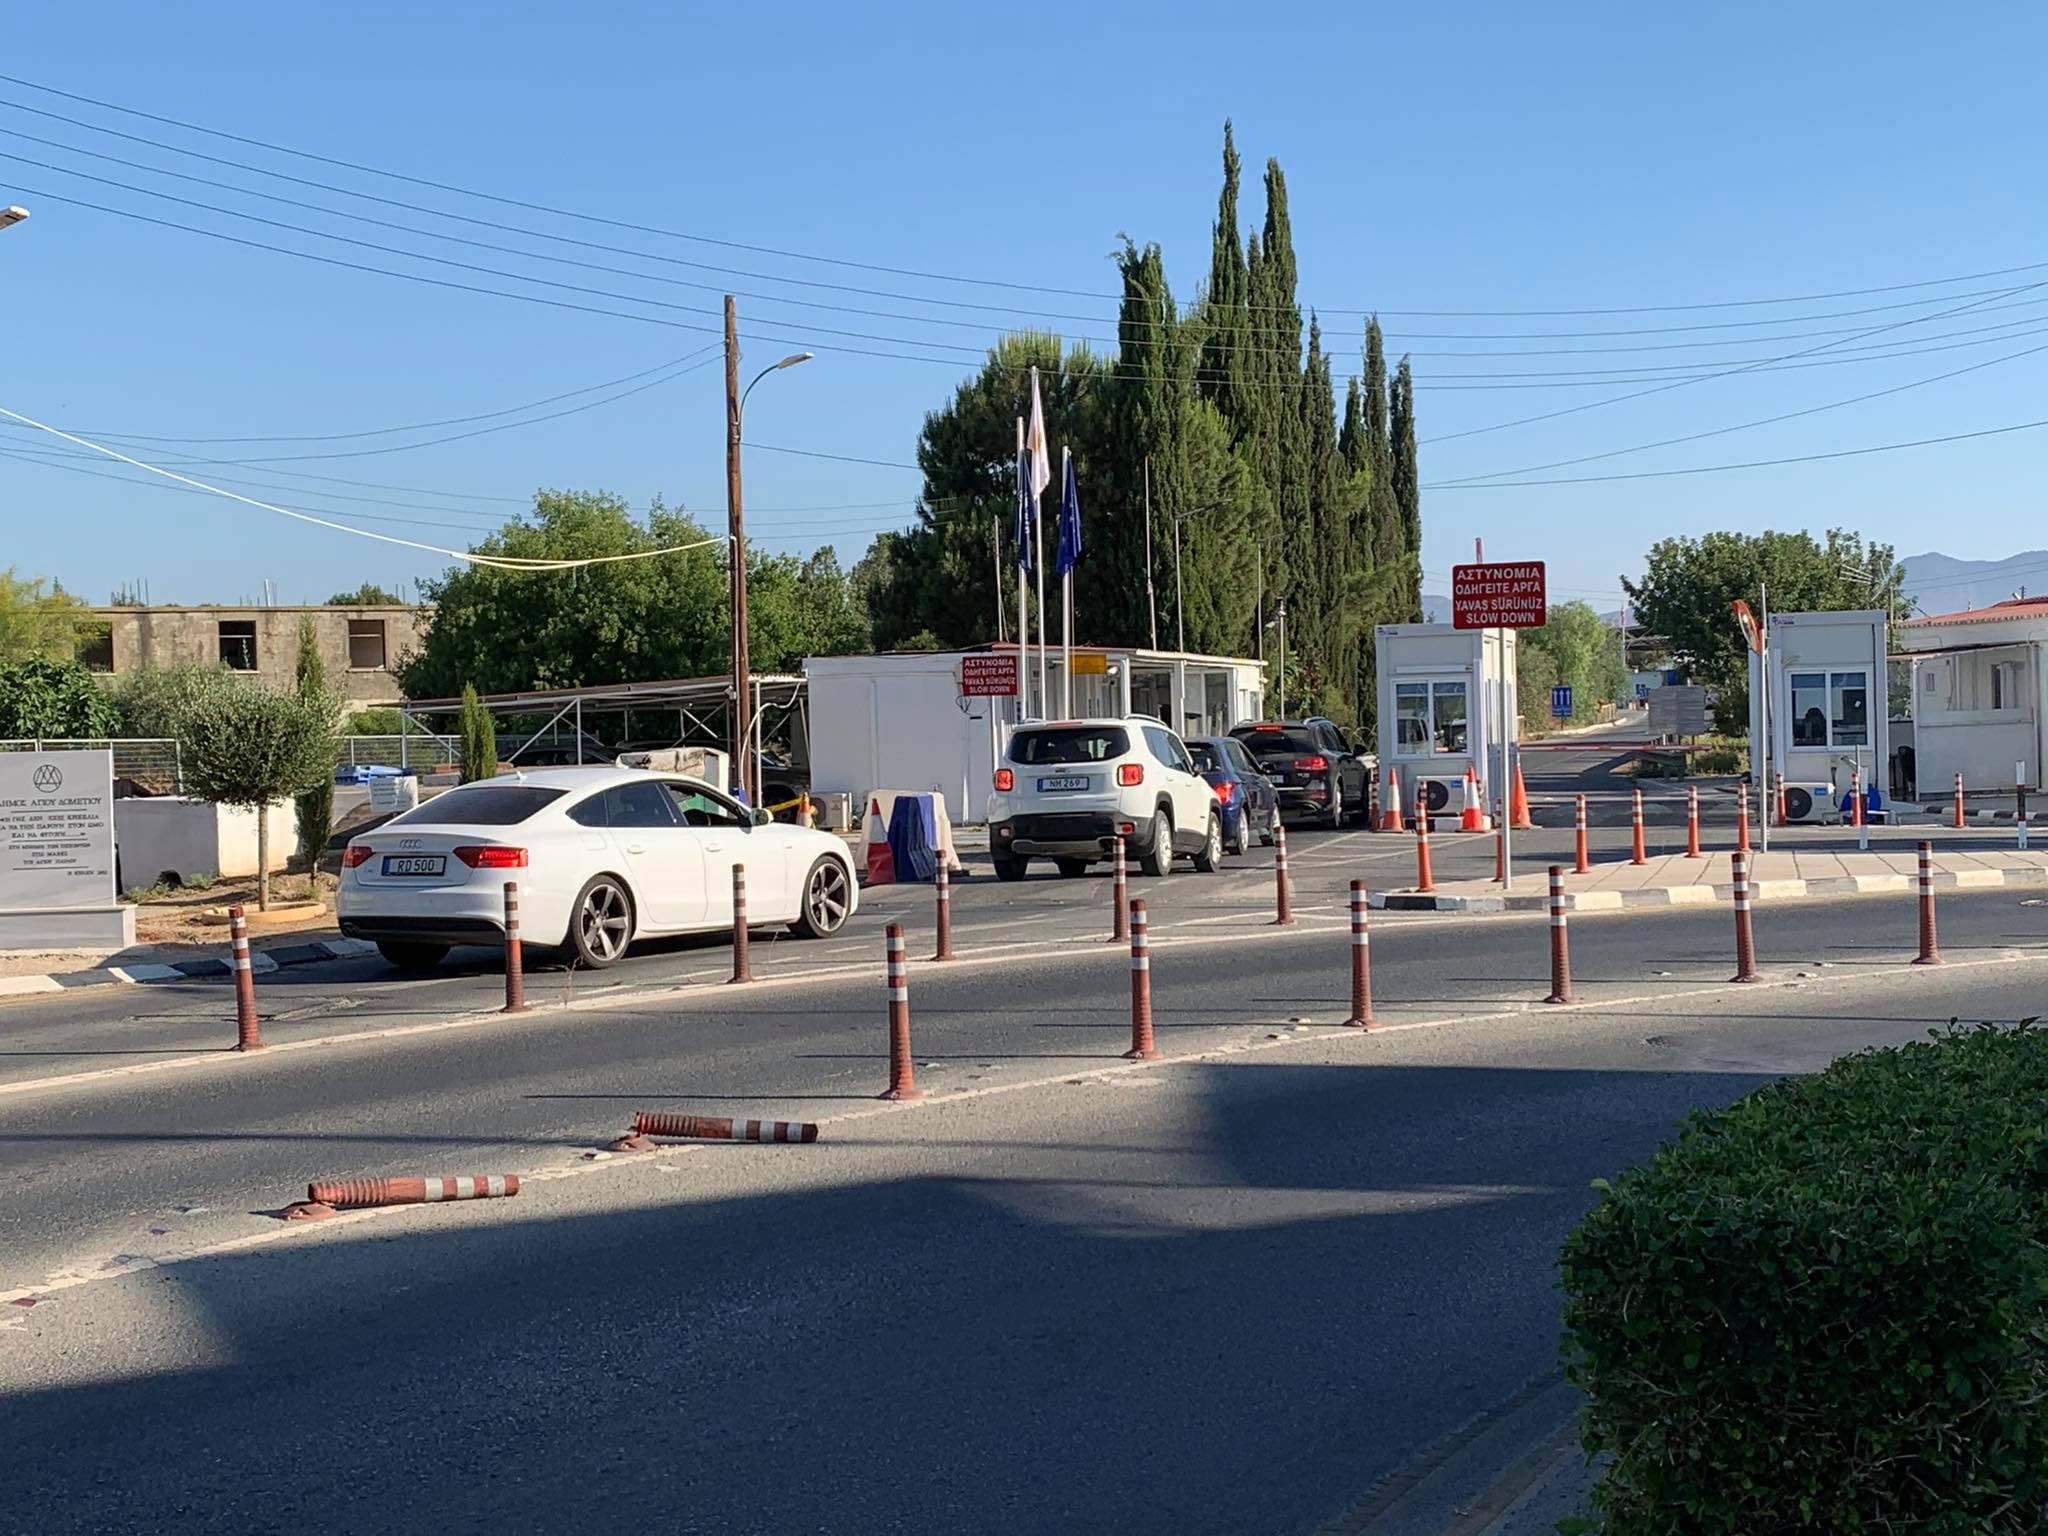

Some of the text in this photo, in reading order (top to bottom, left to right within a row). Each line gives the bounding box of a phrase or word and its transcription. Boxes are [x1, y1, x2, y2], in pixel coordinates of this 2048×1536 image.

[1457, 567, 1540, 580] ΑΣΤΥΝΟΜΙΑ
[1455, 582, 1541, 595] ΟΔΗΓΕΙΤΕ ΑΡΓΑ
[1466, 612, 1535, 624] SLOW DOWN
[965, 659, 1014, 667] ΑΣΤΥΝΟΜΙΑ
[1063, 779, 1081, 788] 269
[414, 859, 435, 872] 500
